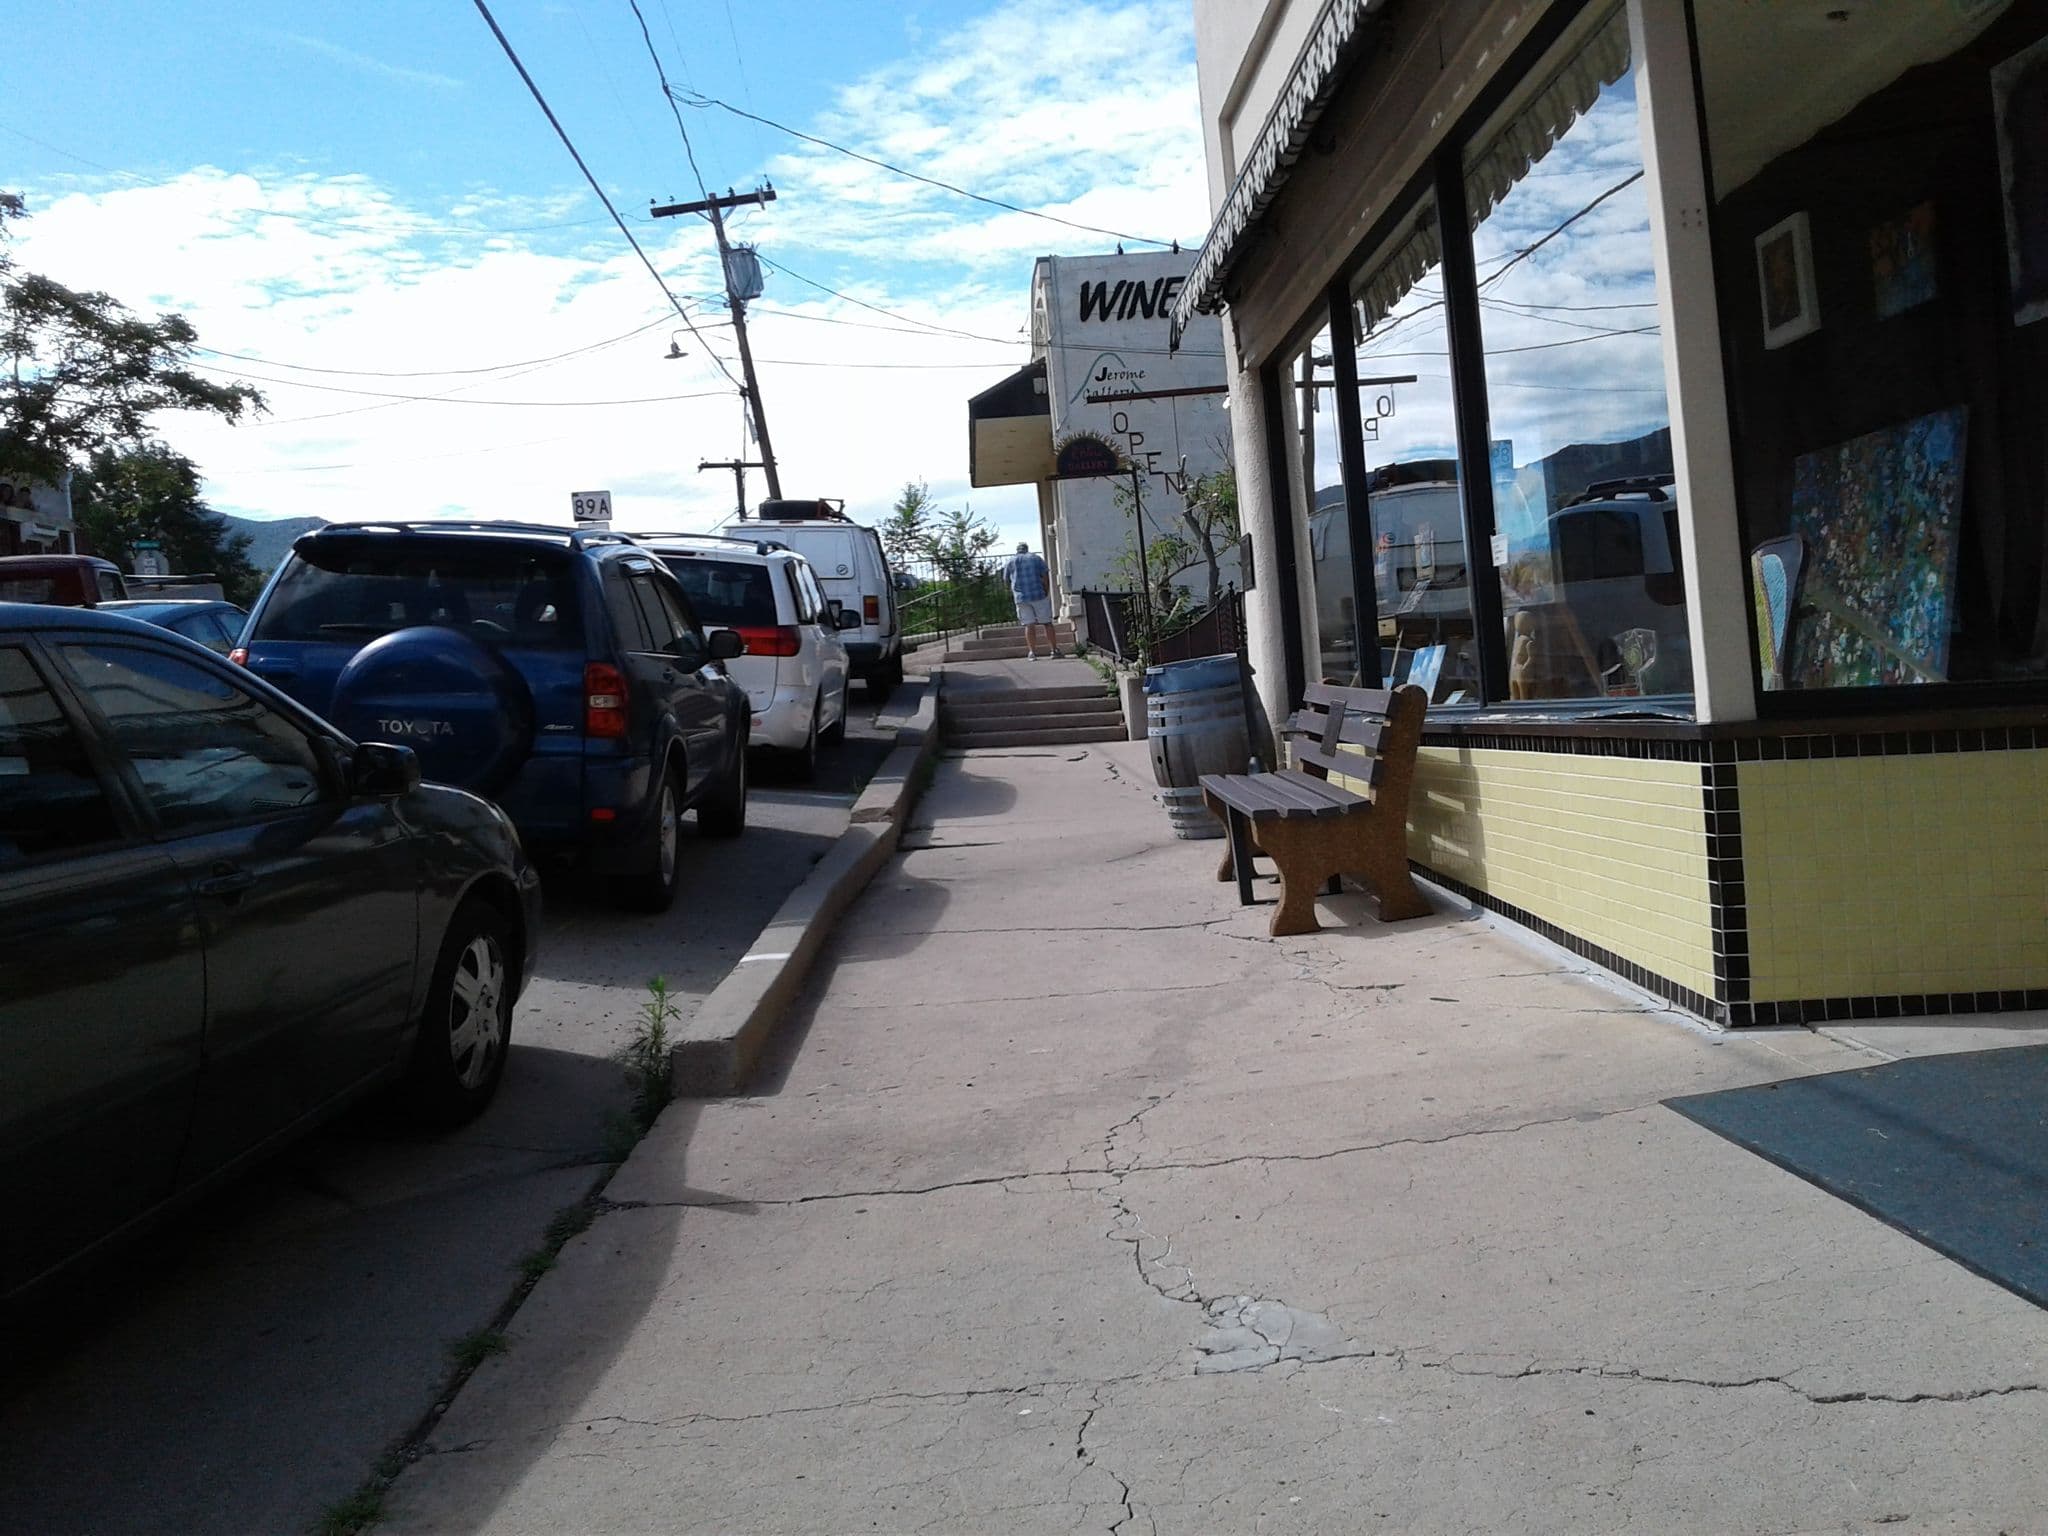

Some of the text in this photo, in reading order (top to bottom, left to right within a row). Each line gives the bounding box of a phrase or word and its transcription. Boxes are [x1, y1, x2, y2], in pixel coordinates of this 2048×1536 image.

[1080, 276, 1186, 322] WINE
[1094, 366, 1146, 382] Jerome
[1113, 411, 1182, 495] OPEN
[575, 498, 609, 516] 89A
